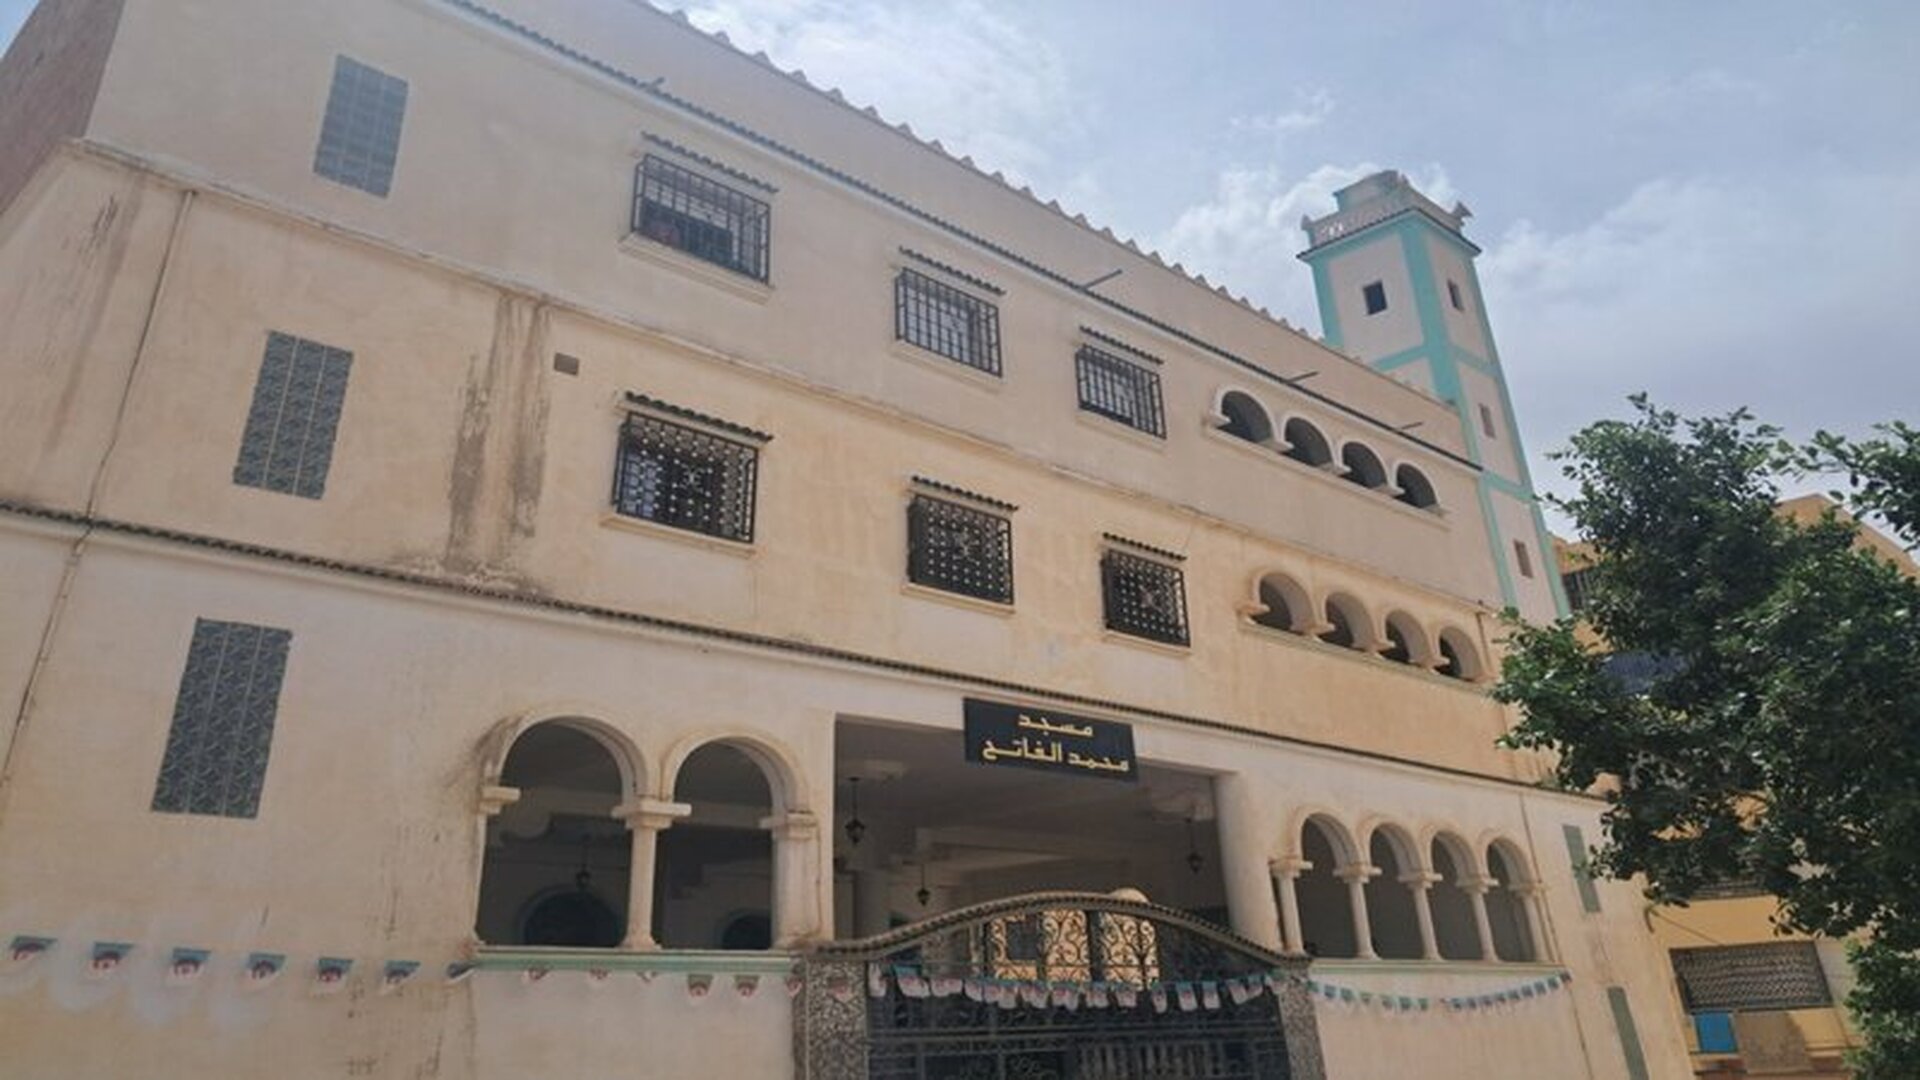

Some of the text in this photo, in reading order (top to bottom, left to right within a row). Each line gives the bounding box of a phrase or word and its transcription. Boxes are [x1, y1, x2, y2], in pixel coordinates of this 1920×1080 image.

[1018, 714, 1093, 736] مسجد
[981, 737, 1130, 772] محمد الفاتح
